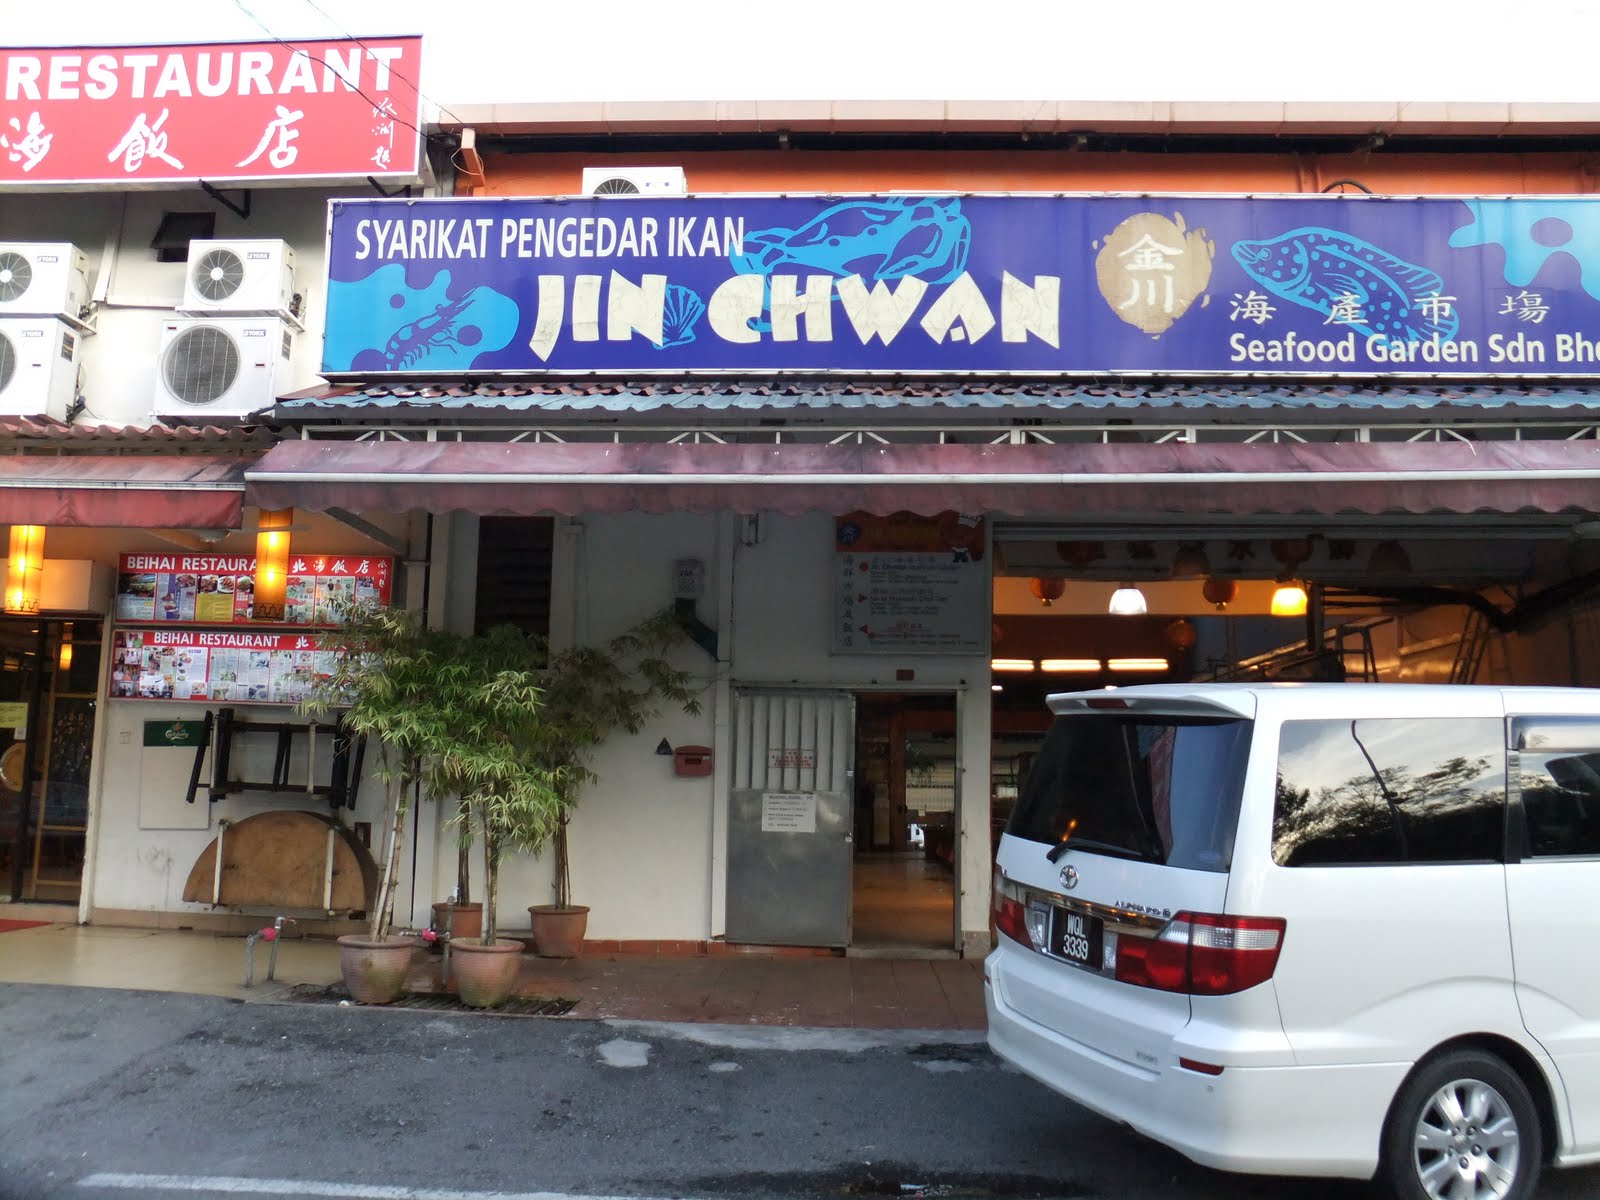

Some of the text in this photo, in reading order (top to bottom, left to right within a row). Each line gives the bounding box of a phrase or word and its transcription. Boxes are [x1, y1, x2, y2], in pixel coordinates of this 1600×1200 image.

[5, 47, 403, 100] RESTAURANT
[355, 216, 744, 260] SYARIKAT PENGEDAR IKAN
[1117, 233, 1184, 314] 金川
[529, 268, 1061, 362] JIN CHWAN
[1229, 331, 1356, 362] Seafood
[1365, 332, 1478, 362] Garden
[1488, 332, 1546, 362] Sdn
[127, 556, 257, 571] BEIHAI RESTAURA
[154, 631, 280, 647] BEIHAI RESTAURANT
[1067, 913, 1086, 938] WQL
[1063, 934, 1089, 961] 3339
